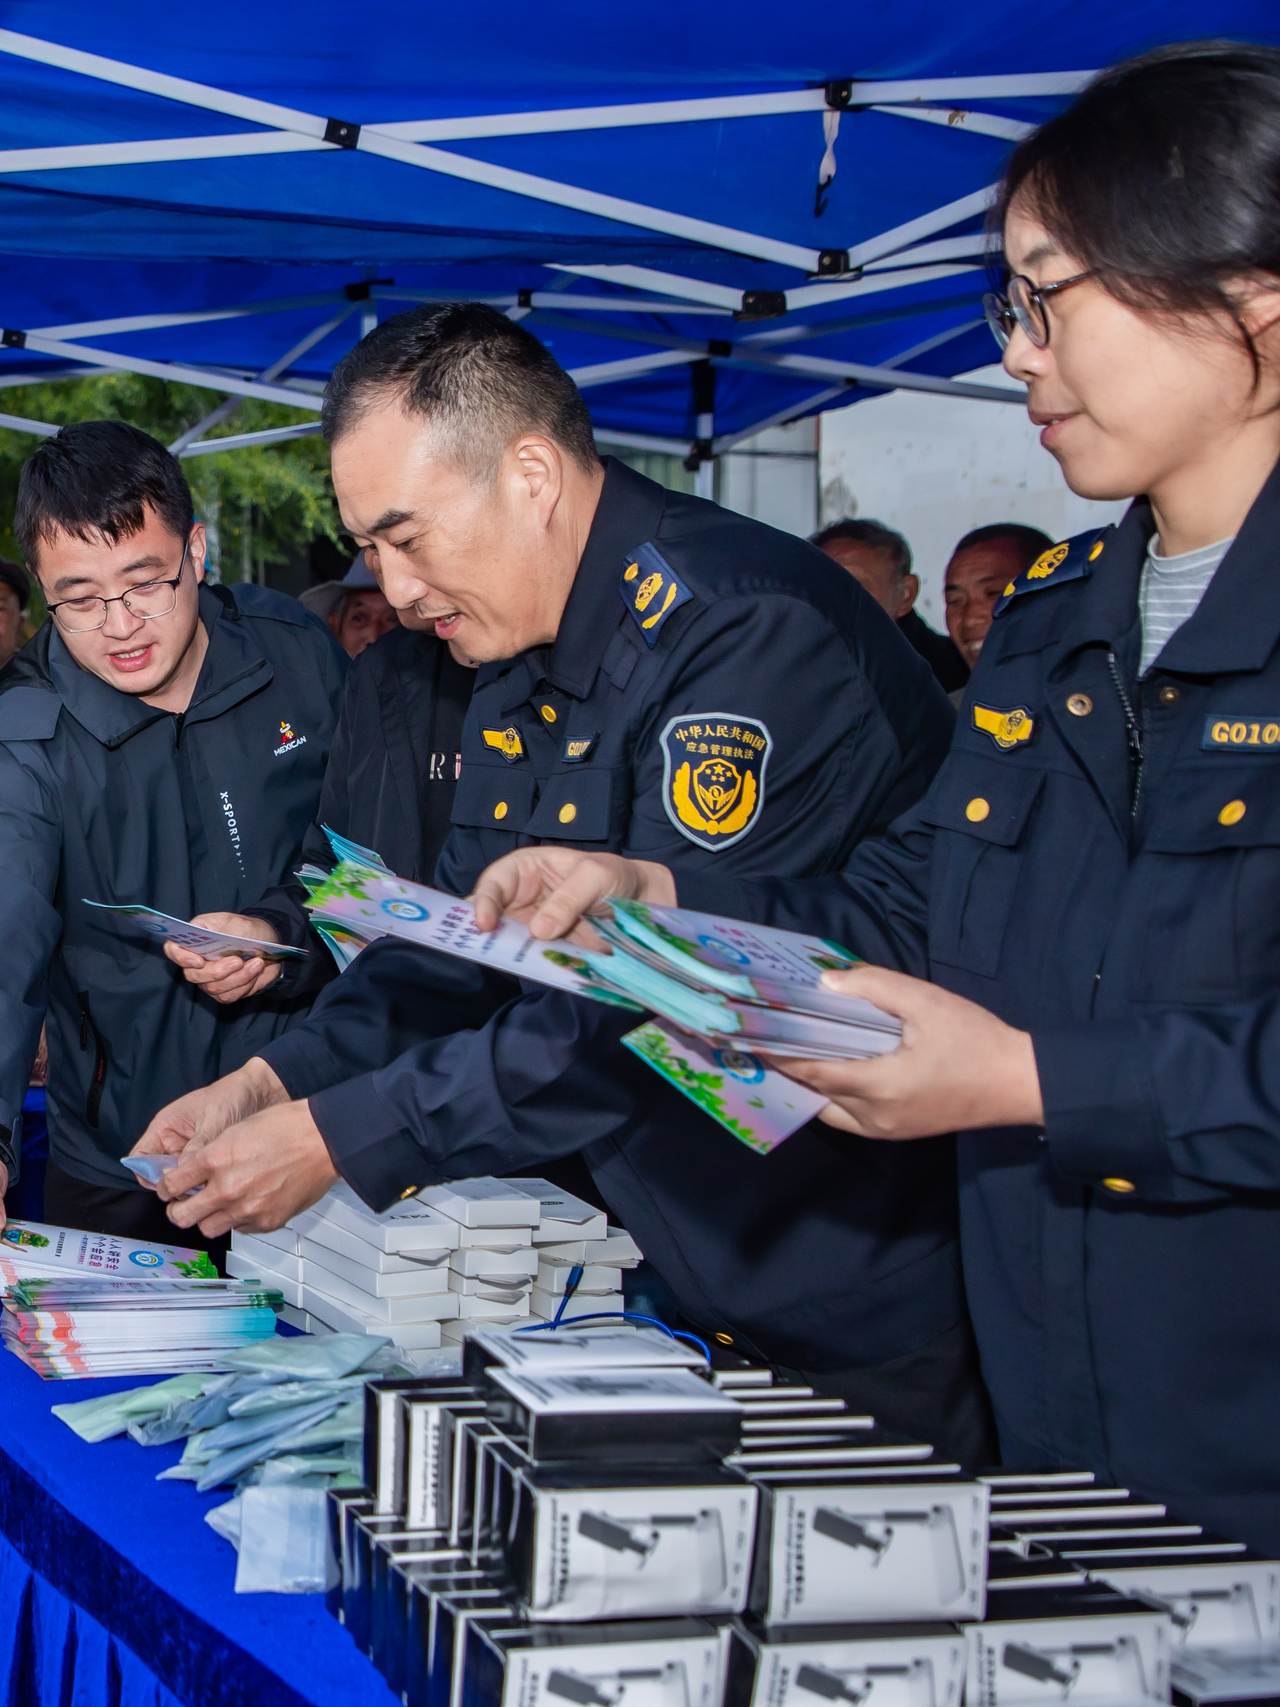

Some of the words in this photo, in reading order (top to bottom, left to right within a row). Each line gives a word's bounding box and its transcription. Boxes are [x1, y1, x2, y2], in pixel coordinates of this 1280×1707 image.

[675, 724, 766, 751] 中华人民共和国
[1211, 721, 1280, 745] G010
[273, 735, 307, 756] MEXICAN
[686, 741, 754, 760] 应急管理执法
[220, 791, 240, 842] X-SPORT
